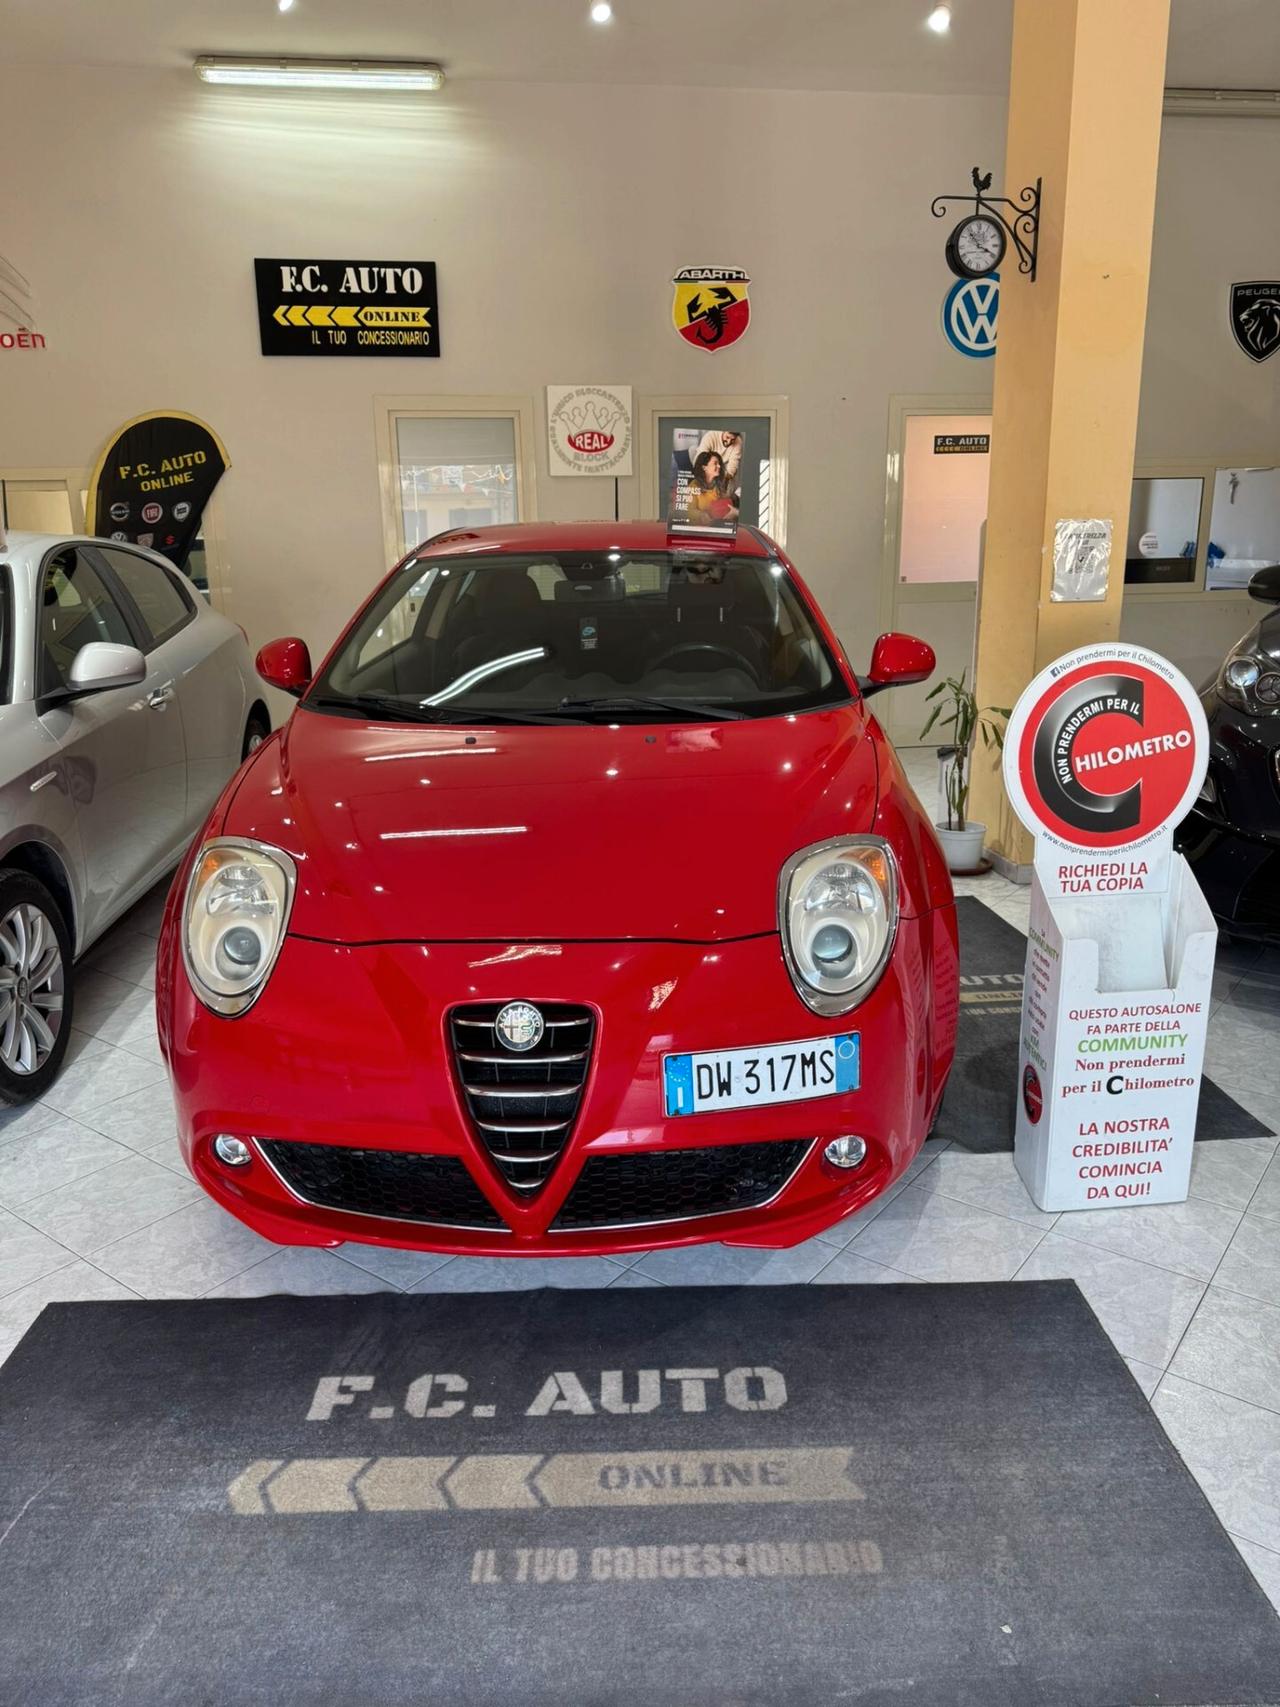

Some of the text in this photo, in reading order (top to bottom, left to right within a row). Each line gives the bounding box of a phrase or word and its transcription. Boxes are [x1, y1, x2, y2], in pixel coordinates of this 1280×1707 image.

[280, 265, 423, 294] F.C. AUTO
[680, 269, 744, 279] ABARTH
[1237, 288, 1280, 296] PEUGE
[363, 311, 420, 322] ONLINE
[311, 330, 430, 345] IL TUO CONCESSIONARIO
[575, 432, 609, 450] REAL
[959, 437, 987, 445] AUTO
[119, 450, 207, 480] F.C. AUTO
[140, 471, 195, 492] ONLINE
[677, 478, 689, 486] CON
[675, 502, 689, 511] FARE
[1059, 659, 1076, 673] Non
[1076, 649, 1116, 666] prendermi
[1117, 649, 1131, 659] per
[1137, 653, 1175, 680] Chilometro
[1057, 698, 1140, 784] NON PRENDERMI PER IL
[1058, 862, 1148, 879] RICHIEDI LA
[1061, 877, 1144, 893] TUA COPIA
[1068, 1003, 1202, 1021] QUESTO AUTOSALONE
[1087, 1020, 1181, 1035] FA PARTE DELLA
[1078, 1034, 1189, 1053] COMMUNITY
[1075, 1053, 1185, 1073] Non prendermi
[696, 1060, 732, 1099] DW
[744, 1050, 835, 1094] 317MS
[1062, 1084, 1087, 1097] per
[1091, 1080, 1102, 1092] il
[1079, 1117, 1170, 1136] LA NOSTRA
[1079, 1161, 1163, 1179] COMINCIA
[1087, 1182, 1151, 1199] DA QUI!
[305, 1366, 788, 1421] F.C. AUTO
[599, 1460, 787, 1490] ONLINE
[470, 1541, 884, 1583] IL TUO CONCESSIONARIO
